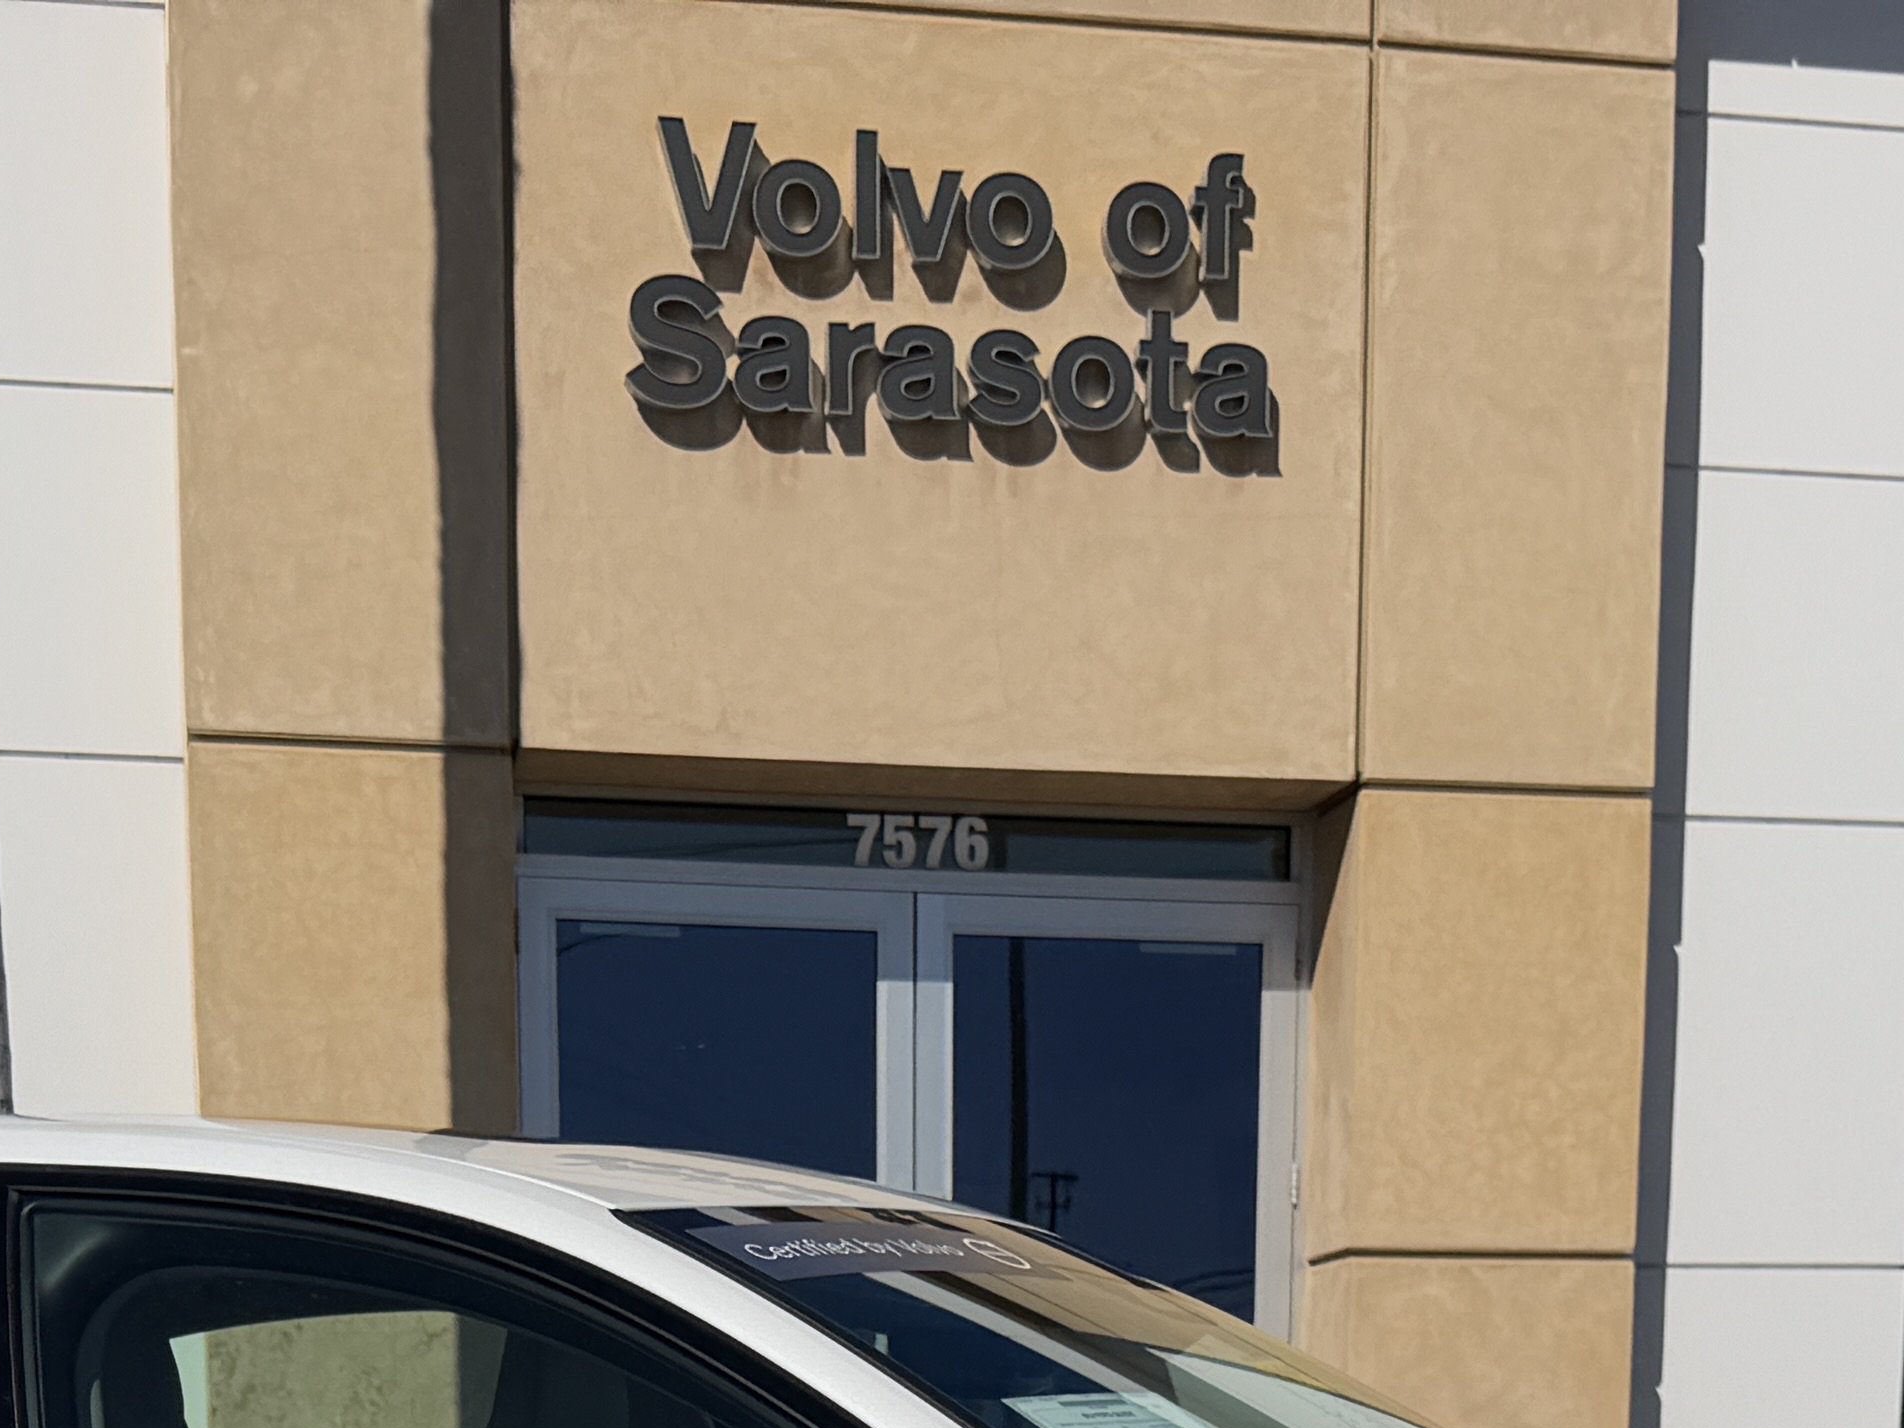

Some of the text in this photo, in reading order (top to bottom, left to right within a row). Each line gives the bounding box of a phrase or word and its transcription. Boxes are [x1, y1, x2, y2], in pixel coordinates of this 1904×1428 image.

[657, 114, 1246, 282] Volvo of
[625, 274, 1274, 439] Sarasota
[846, 811, 989, 872] 7576
[744, 1237, 867, 1260] Certified
